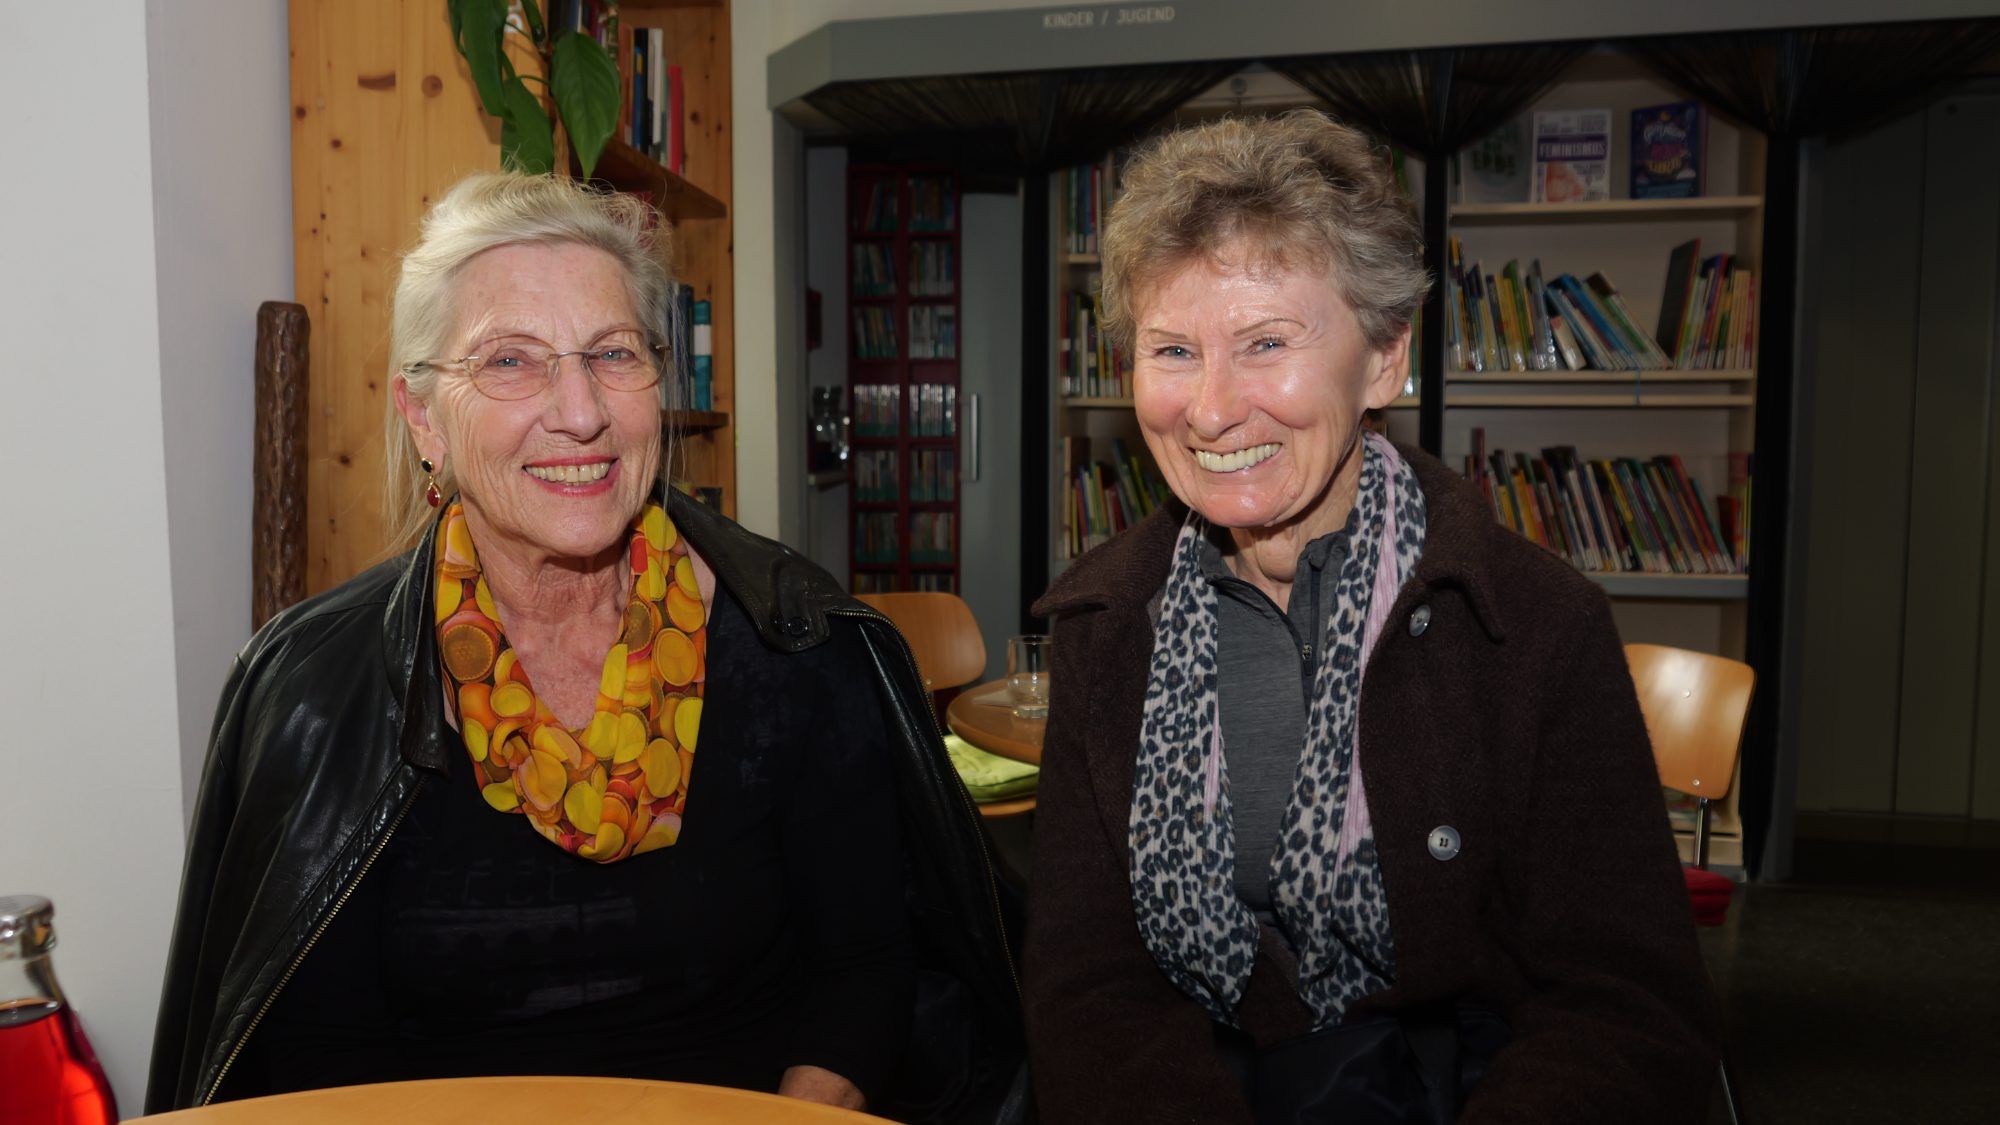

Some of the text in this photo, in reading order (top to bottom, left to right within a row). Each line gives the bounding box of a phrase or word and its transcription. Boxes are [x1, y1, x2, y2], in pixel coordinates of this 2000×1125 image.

[1044, 11, 1095, 27] KINDER
[1117, 6, 1176, 23] JUGEND
[1539, 142, 1606, 158] FEMINISMUS
